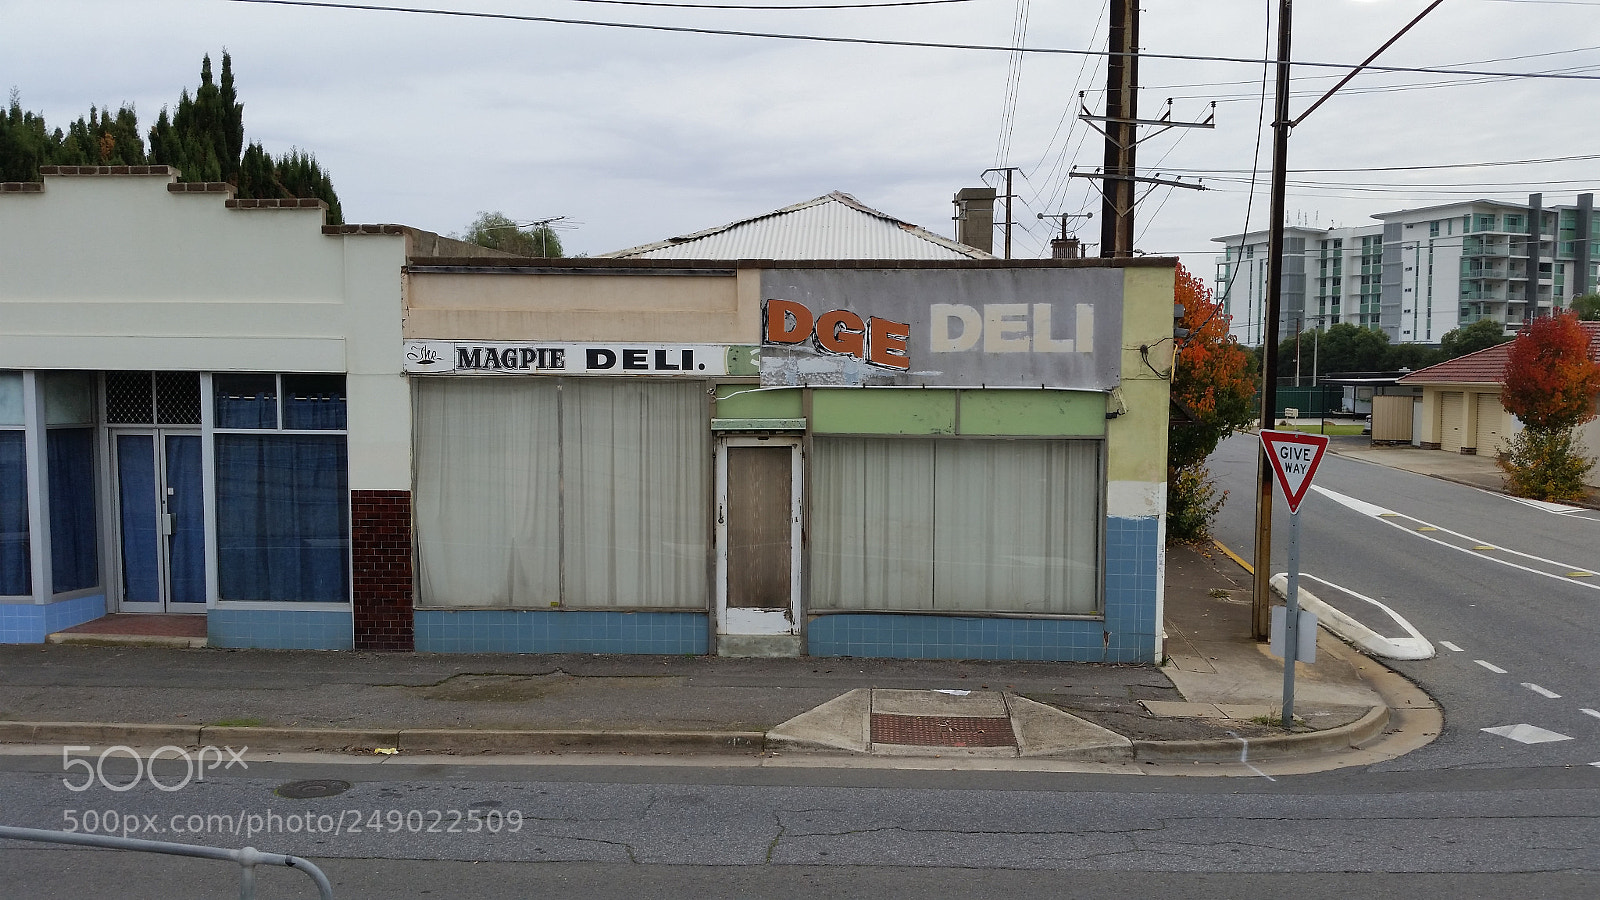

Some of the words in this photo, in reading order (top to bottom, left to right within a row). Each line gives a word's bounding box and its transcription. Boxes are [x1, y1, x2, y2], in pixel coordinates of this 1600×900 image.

[763, 299, 910, 371] DGE
[930, 303, 1095, 353] DELI
[406, 345, 443, 362] The
[456, 346, 566, 371] MAGPIE
[586, 348, 706, 371] DELI.
[1280, 446, 1310, 461] GIVE
[1285, 462, 1307, 474] WAY
